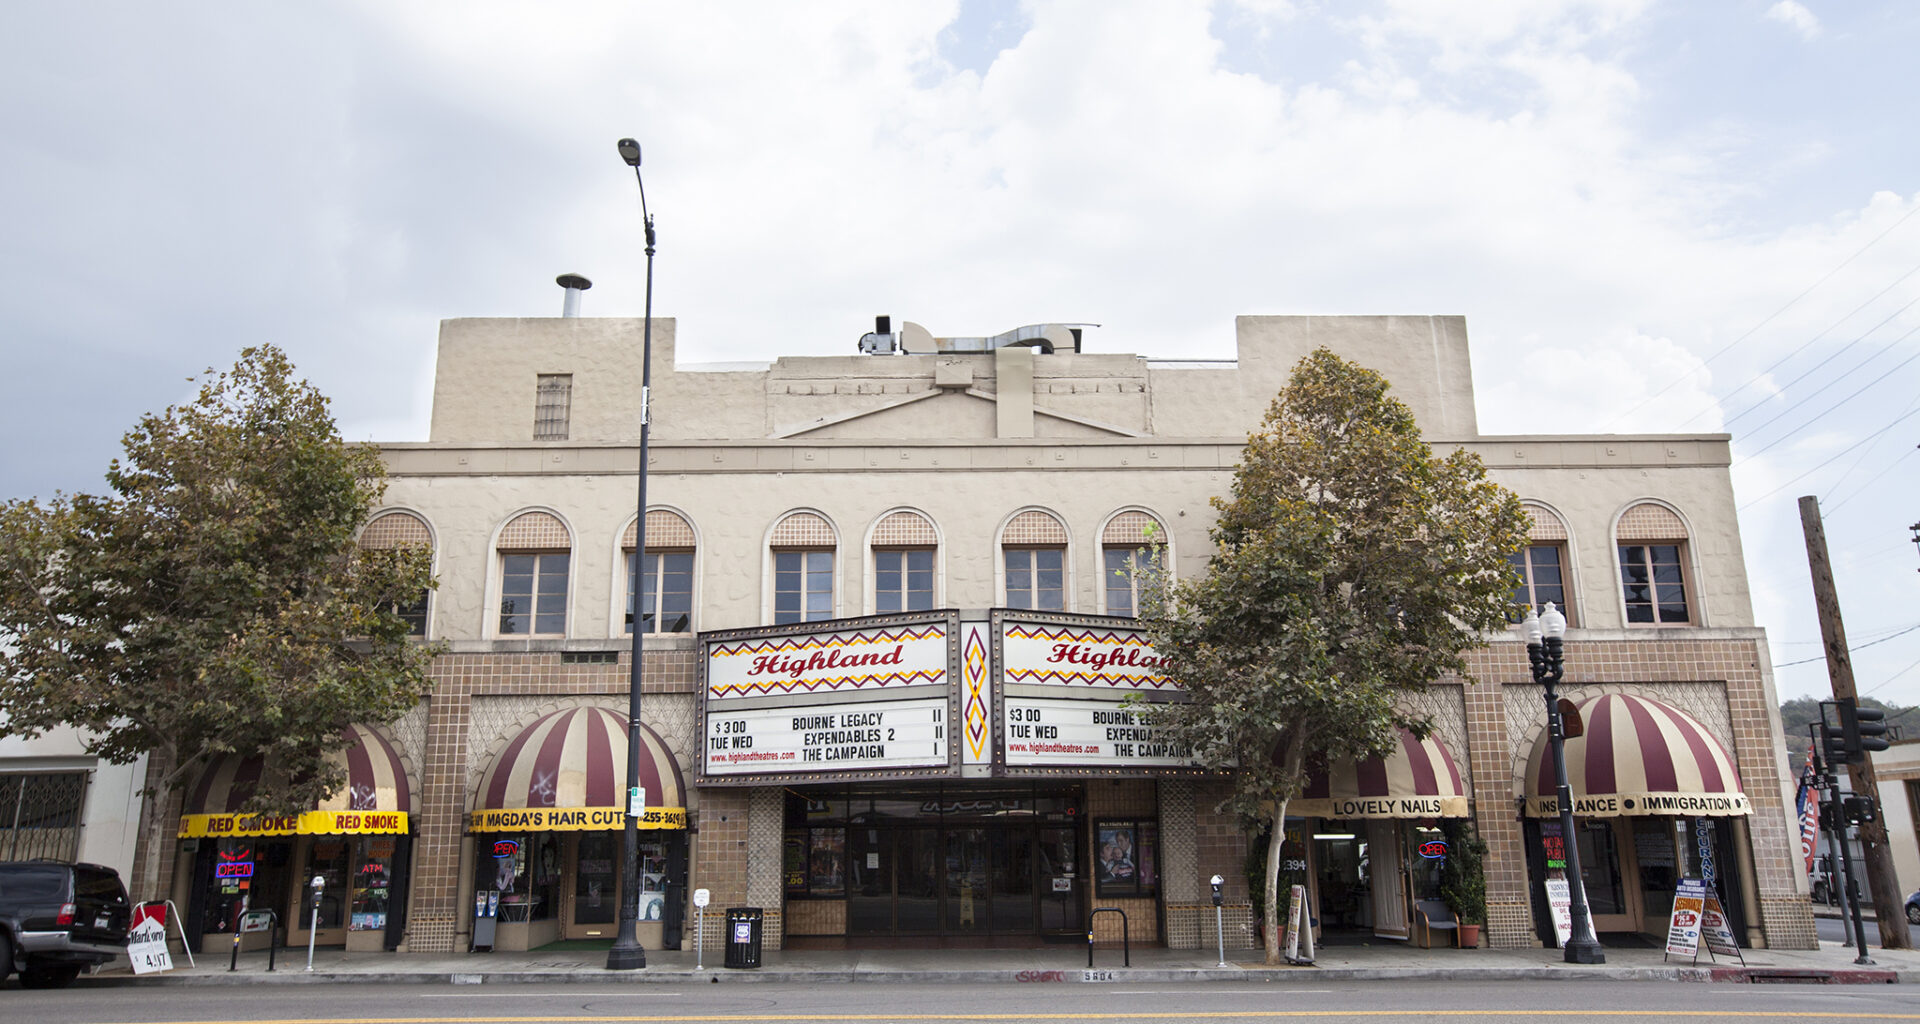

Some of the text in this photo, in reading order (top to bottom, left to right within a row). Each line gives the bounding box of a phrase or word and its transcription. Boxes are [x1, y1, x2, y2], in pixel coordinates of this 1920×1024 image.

[747, 645, 904, 678] Highland
[1046, 644, 1174, 671] Highlan
[792, 715, 835, 730] BOURNE
[841, 713, 883, 728] LEGACY
[1093, 711, 1134, 725] BOURNE
[804, 729, 881, 745] EXPENDABLES
[887, 728, 895, 741] 2
[1010, 724, 1057, 739] TUE WED
[710, 735, 753, 750] TUE WED
[802, 748, 822, 761] THE
[825, 745, 885, 760] CAMPAIGN
[1114, 743, 1193, 758] THE CAMPAIGN
[1334, 800, 1441, 815] LOVELY NAILS
[1540, 799, 1617, 813] INSANCE
[1643, 797, 1731, 810] IMMIGRATION
[207, 818, 234, 833] RED
[238, 815, 297, 832] SMOKE
[336, 815, 399, 829] RED SMOKE
[486, 811, 543, 827] MAGDA'S
[548, 811, 588, 825] HAIR
[1418, 843, 1447, 855] OPEN
[1546, 848, 1566, 860] PUBLI
[217, 863, 252, 876] OPEN
[362, 864, 383, 873] ATM
